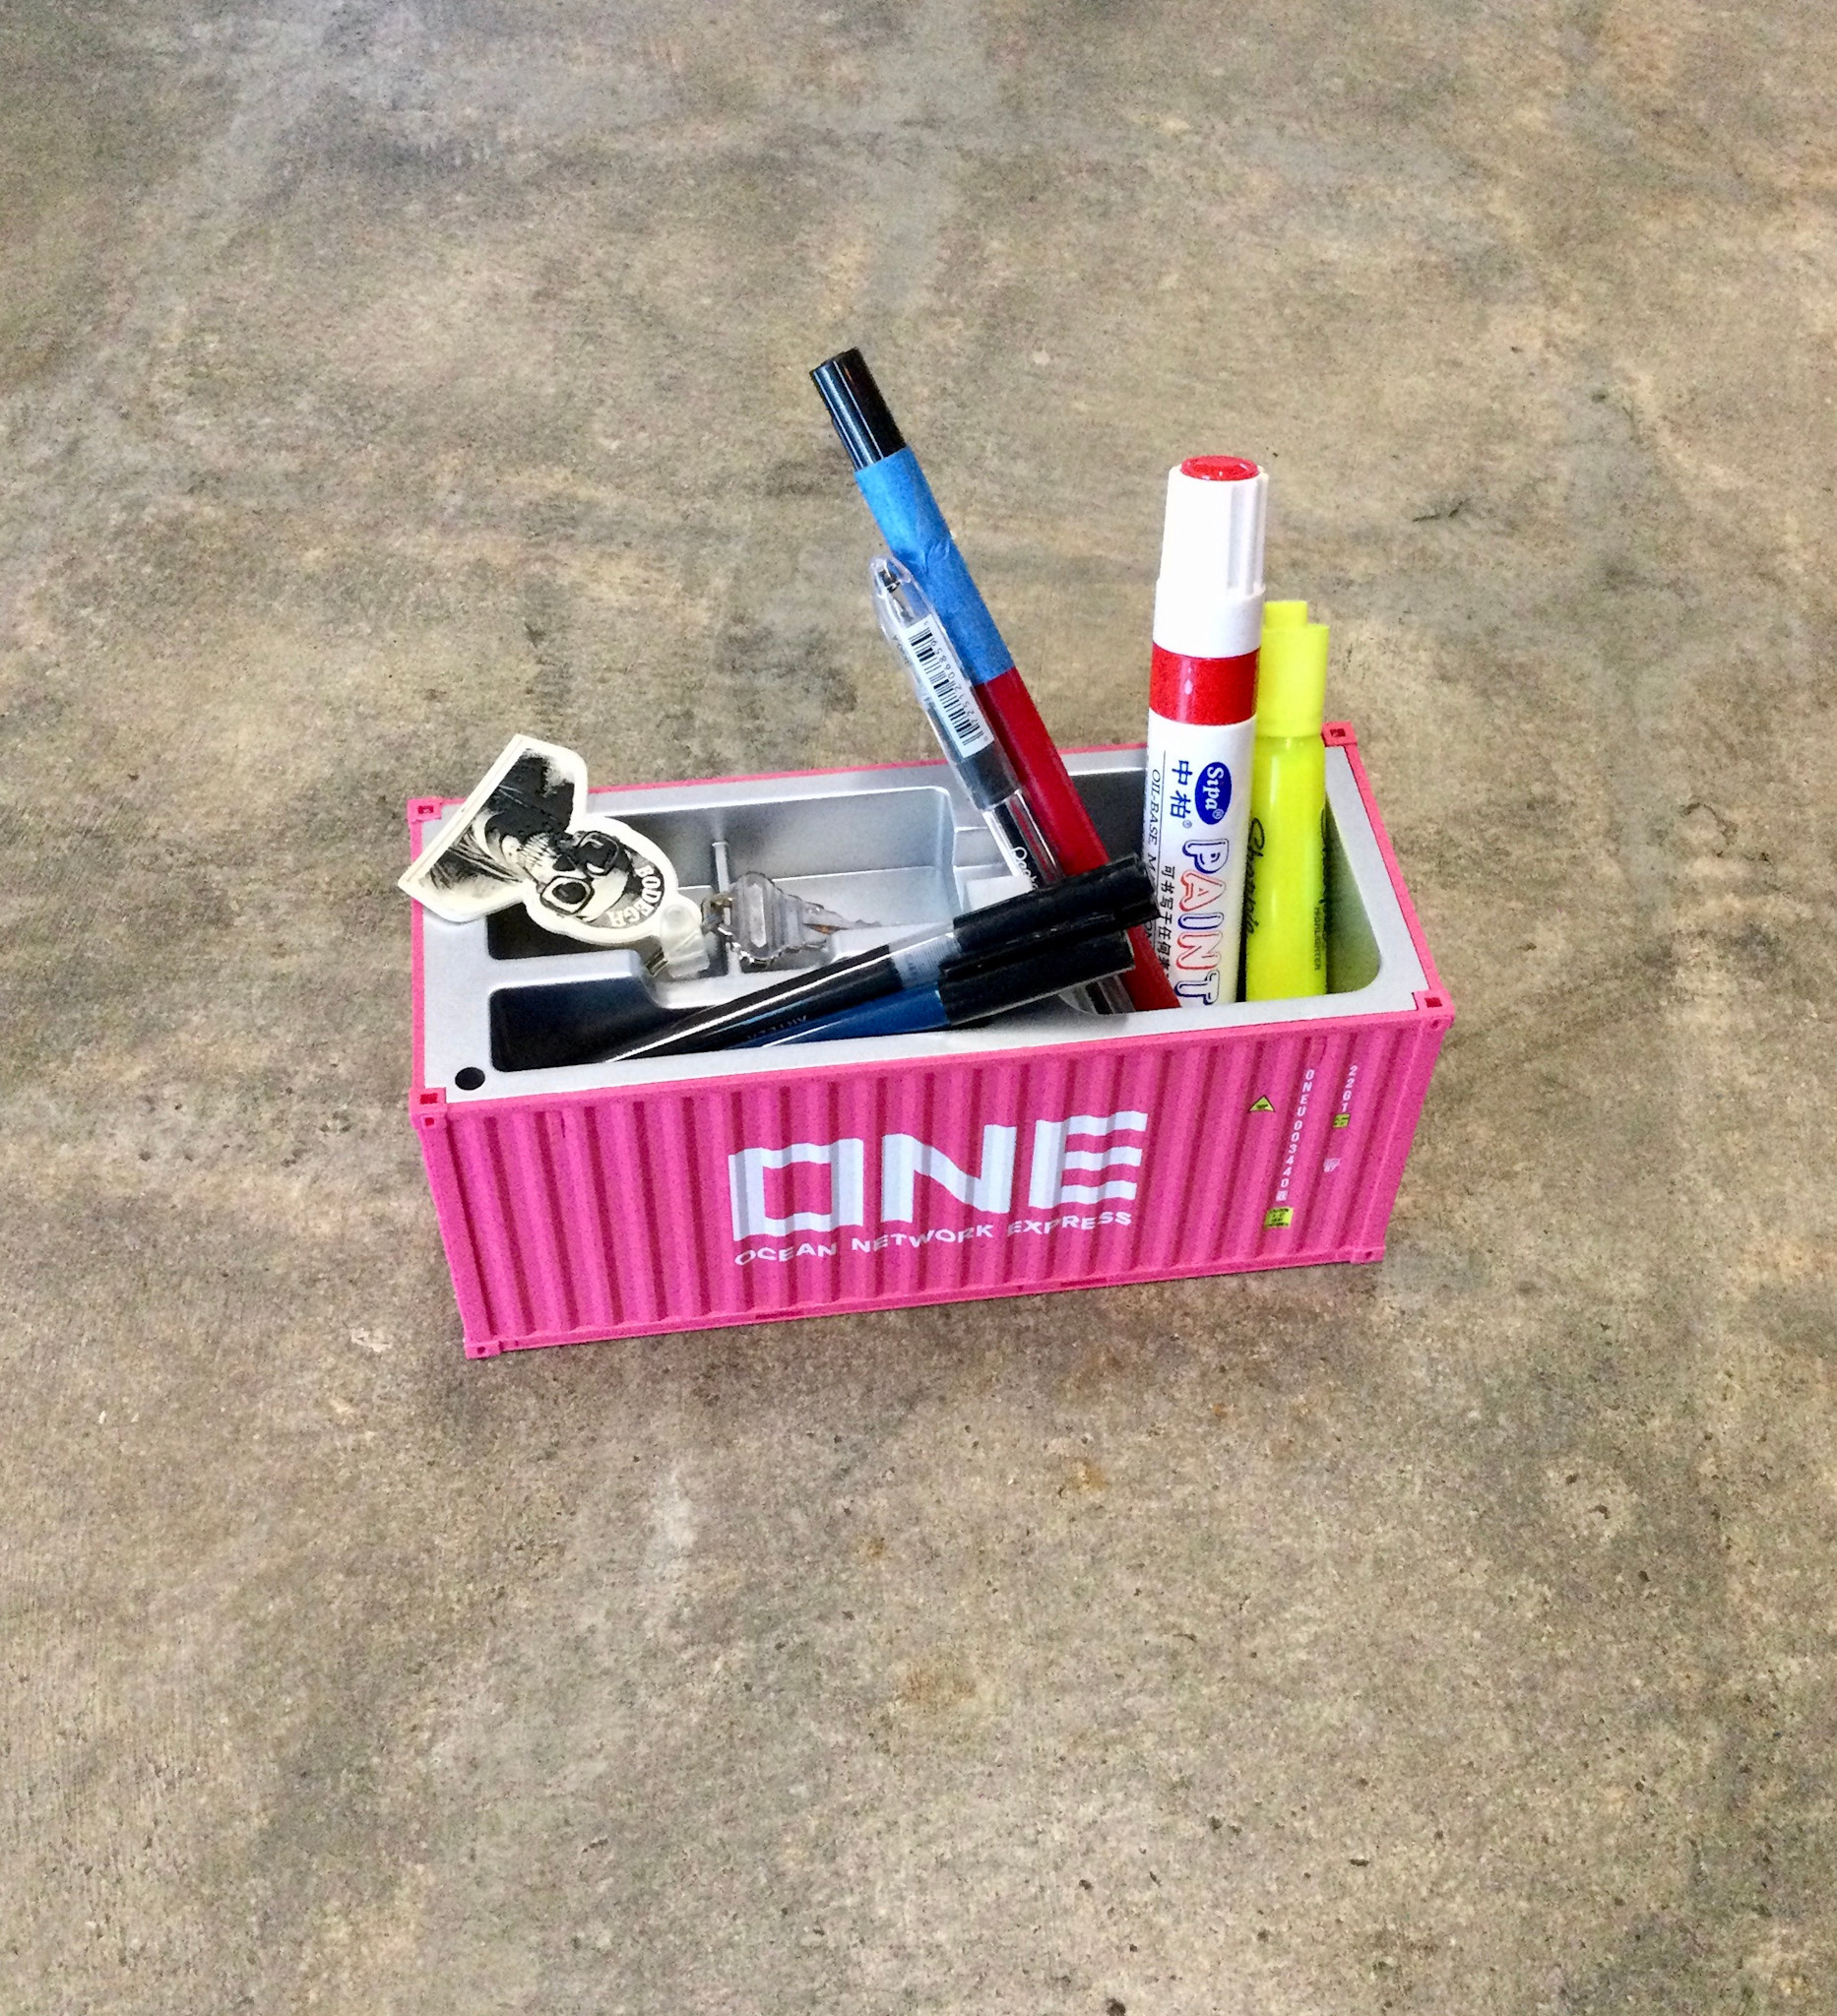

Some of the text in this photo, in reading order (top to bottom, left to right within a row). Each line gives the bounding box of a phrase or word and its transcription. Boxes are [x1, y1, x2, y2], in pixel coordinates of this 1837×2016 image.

[952, 683, 980, 725] 72512
[1148, 769, 1161, 846] OIL-BASE
[1202, 766, 1225, 811] Sipa
[605, 864, 663, 927] BODEGA
[1174, 838, 1230, 1006] PAINT
[728, 1110, 1148, 1241] ONE
[734, 1211, 1132, 1266] OCEAN NETWORK EXPRESS
